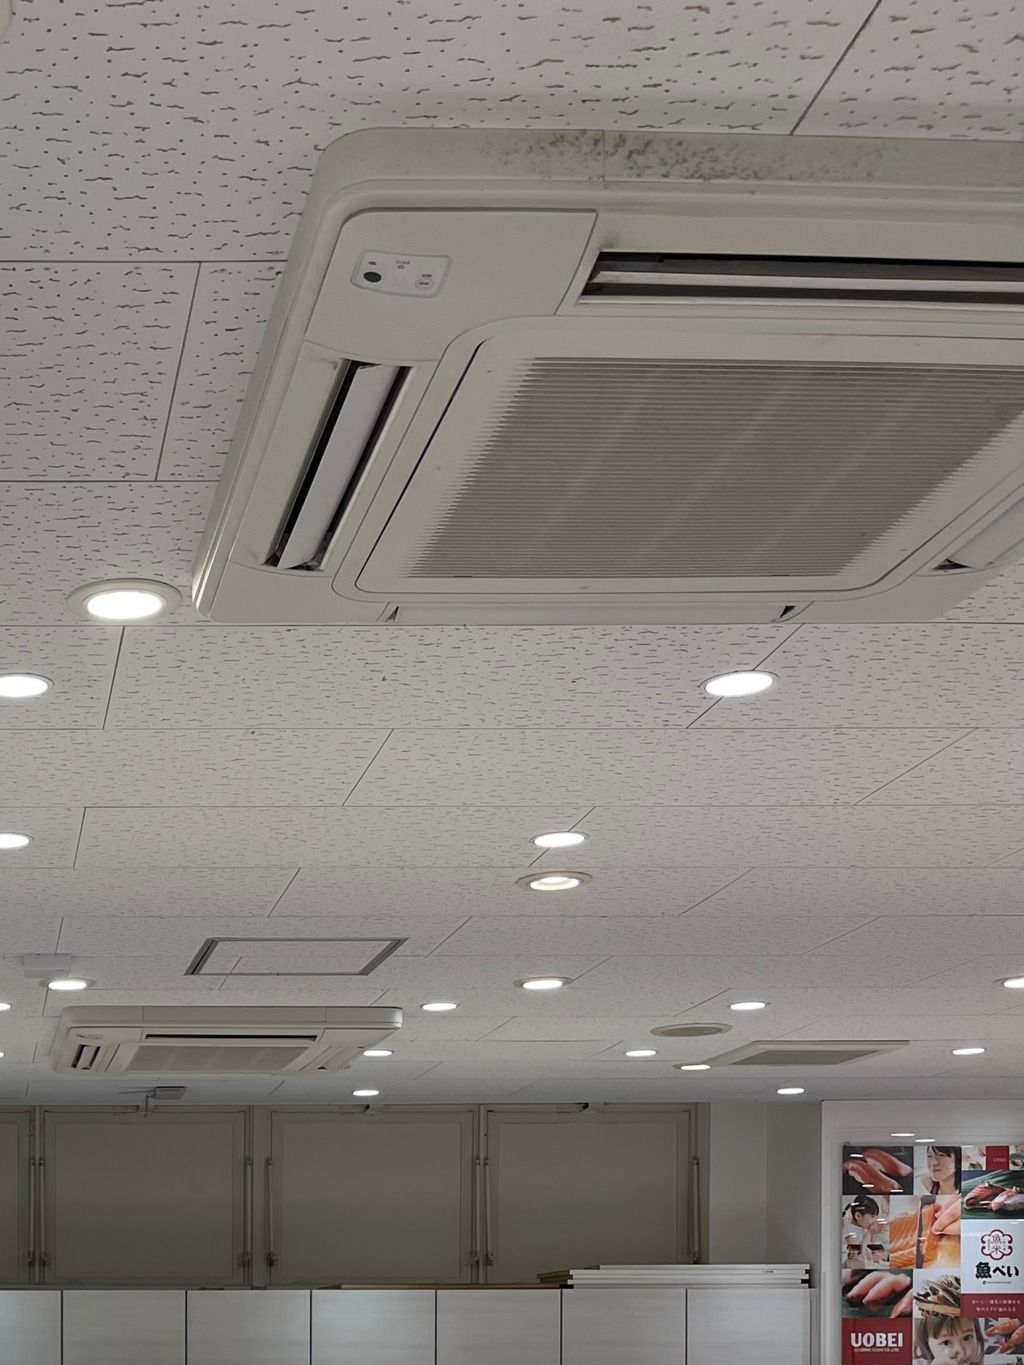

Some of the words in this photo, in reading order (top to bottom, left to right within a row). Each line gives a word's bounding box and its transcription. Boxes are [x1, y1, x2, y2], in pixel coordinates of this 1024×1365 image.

[975, 1262, 1019, 1279] 魚べい
[850, 1332, 904, 1347] UOBEI
